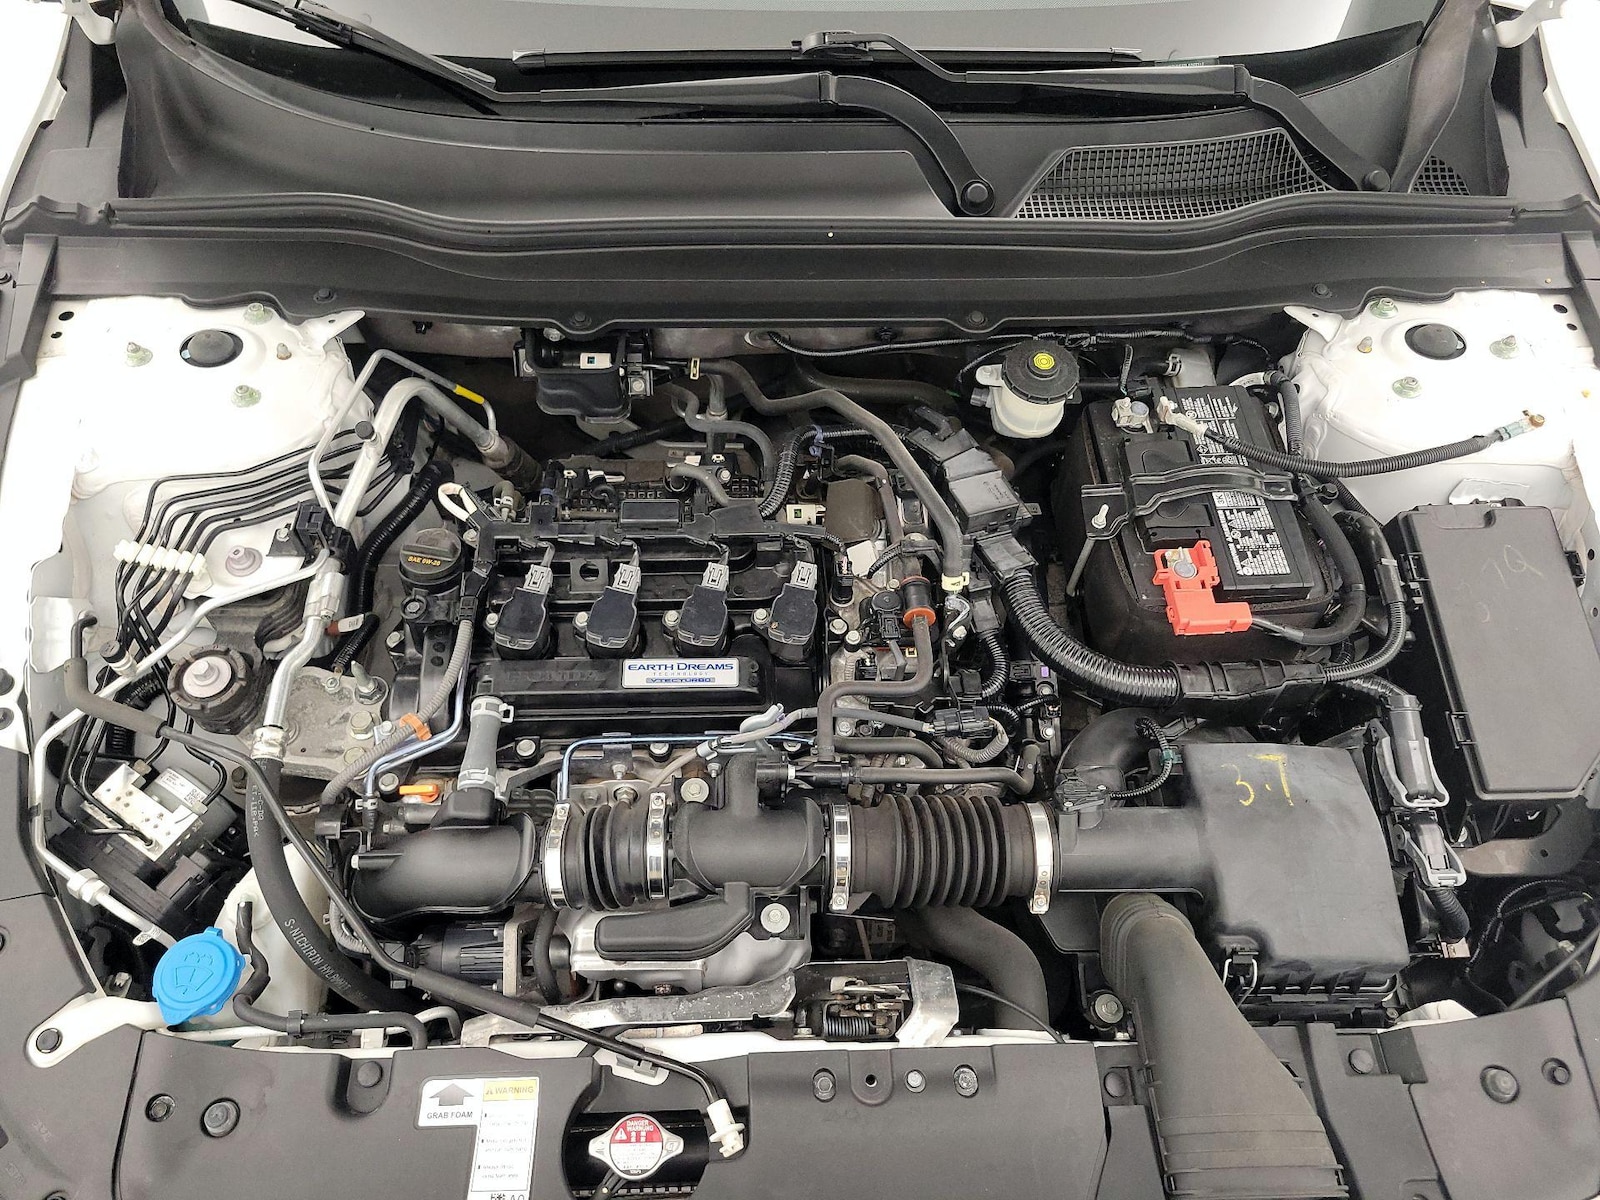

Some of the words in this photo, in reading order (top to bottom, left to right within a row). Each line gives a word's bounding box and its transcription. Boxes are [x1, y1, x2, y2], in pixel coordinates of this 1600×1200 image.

[628, 663, 674, 671] EARTH
[677, 662, 734, 671] DREAMS
[495, 1086, 534, 1095] WARNING
[450, 1111, 473, 1119] FOAM
